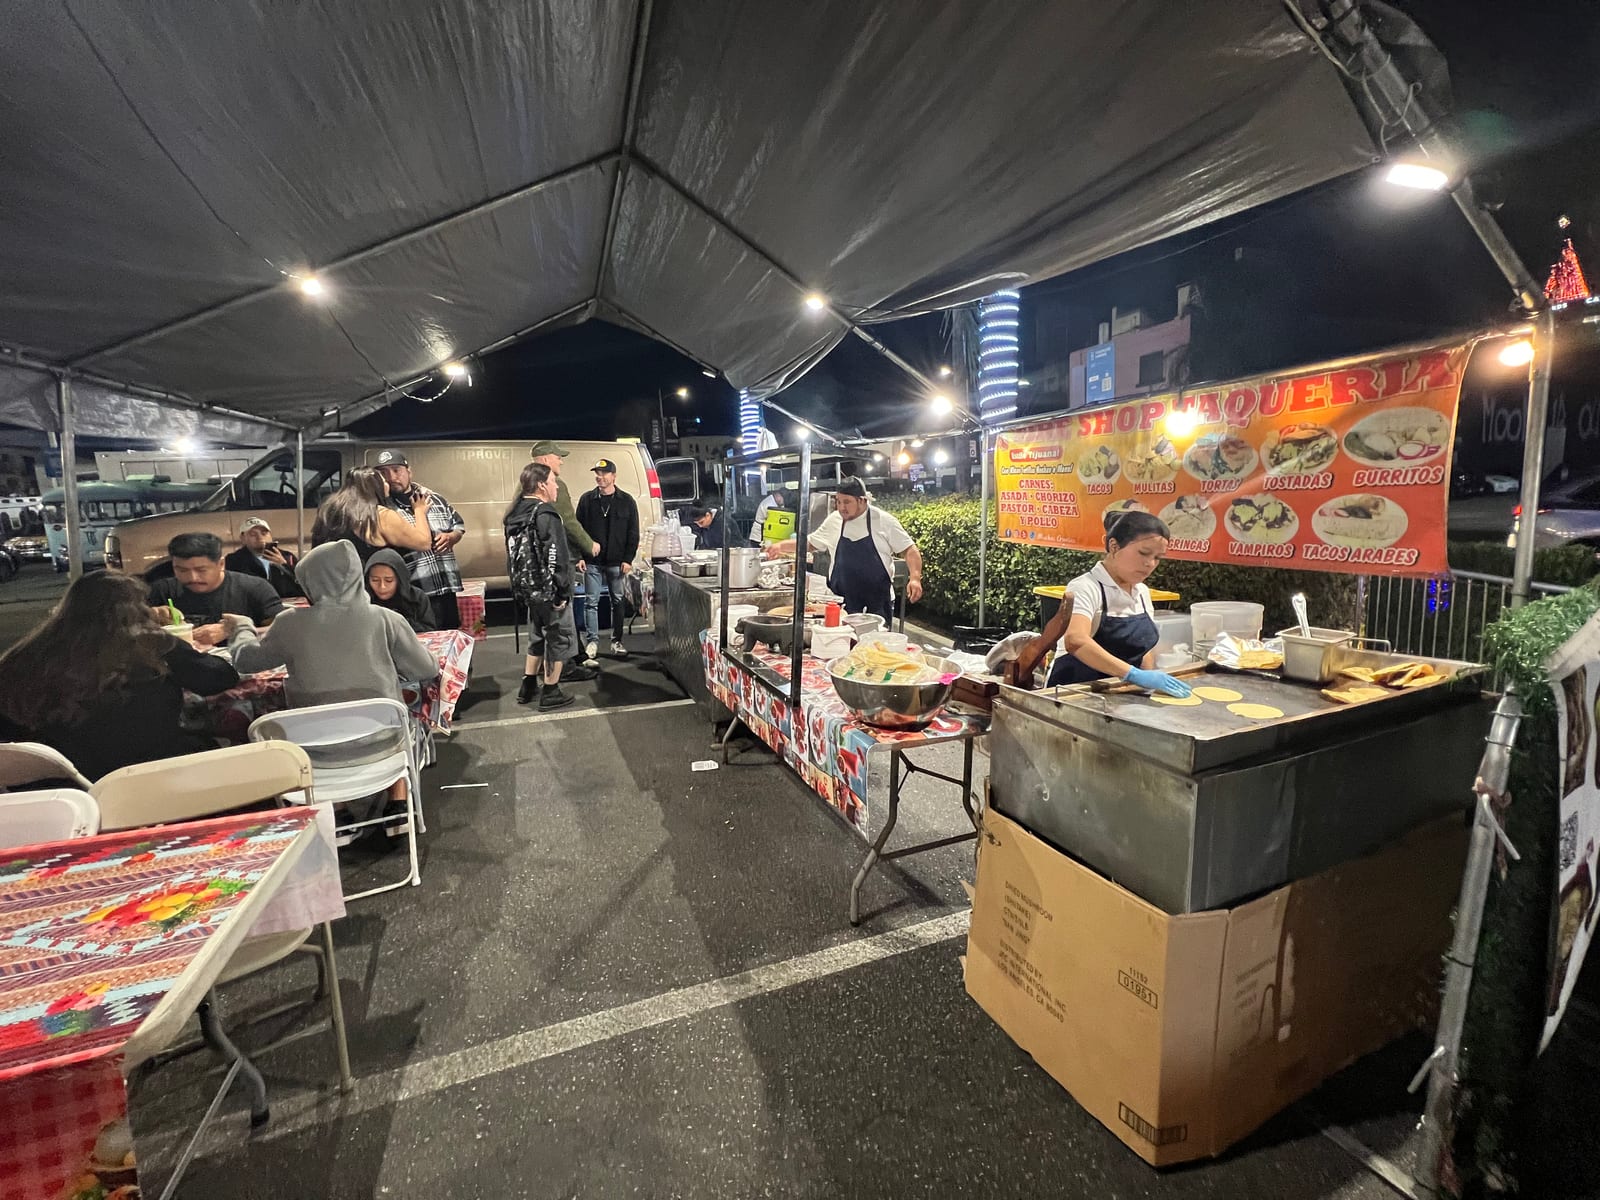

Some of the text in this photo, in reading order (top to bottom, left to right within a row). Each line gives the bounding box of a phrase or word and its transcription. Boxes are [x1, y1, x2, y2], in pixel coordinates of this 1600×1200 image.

[1078, 401, 1166, 436] SHOP
[1263, 472, 1334, 490] TOSTADAS
[1353, 465, 1445, 487] BURRITOS
[1019, 479, 1054, 490] CARNES:
[1087, 483, 1112, 495] TACOS
[1134, 481, 1175, 494] MULITAS
[1201, 478, 1242, 492] TORTAS
[1001, 491, 1076, 503] ASADA CHORIZO
[1001, 503, 1079, 516] PASTOR CABEZA
[1020, 516, 1058, 527] Y POLLO
[1166, 537, 1211, 553] GRINGAS
[1228, 541, 1295, 559] VAMPIROS
[1303, 544, 1419, 566] TACOS ARABES
